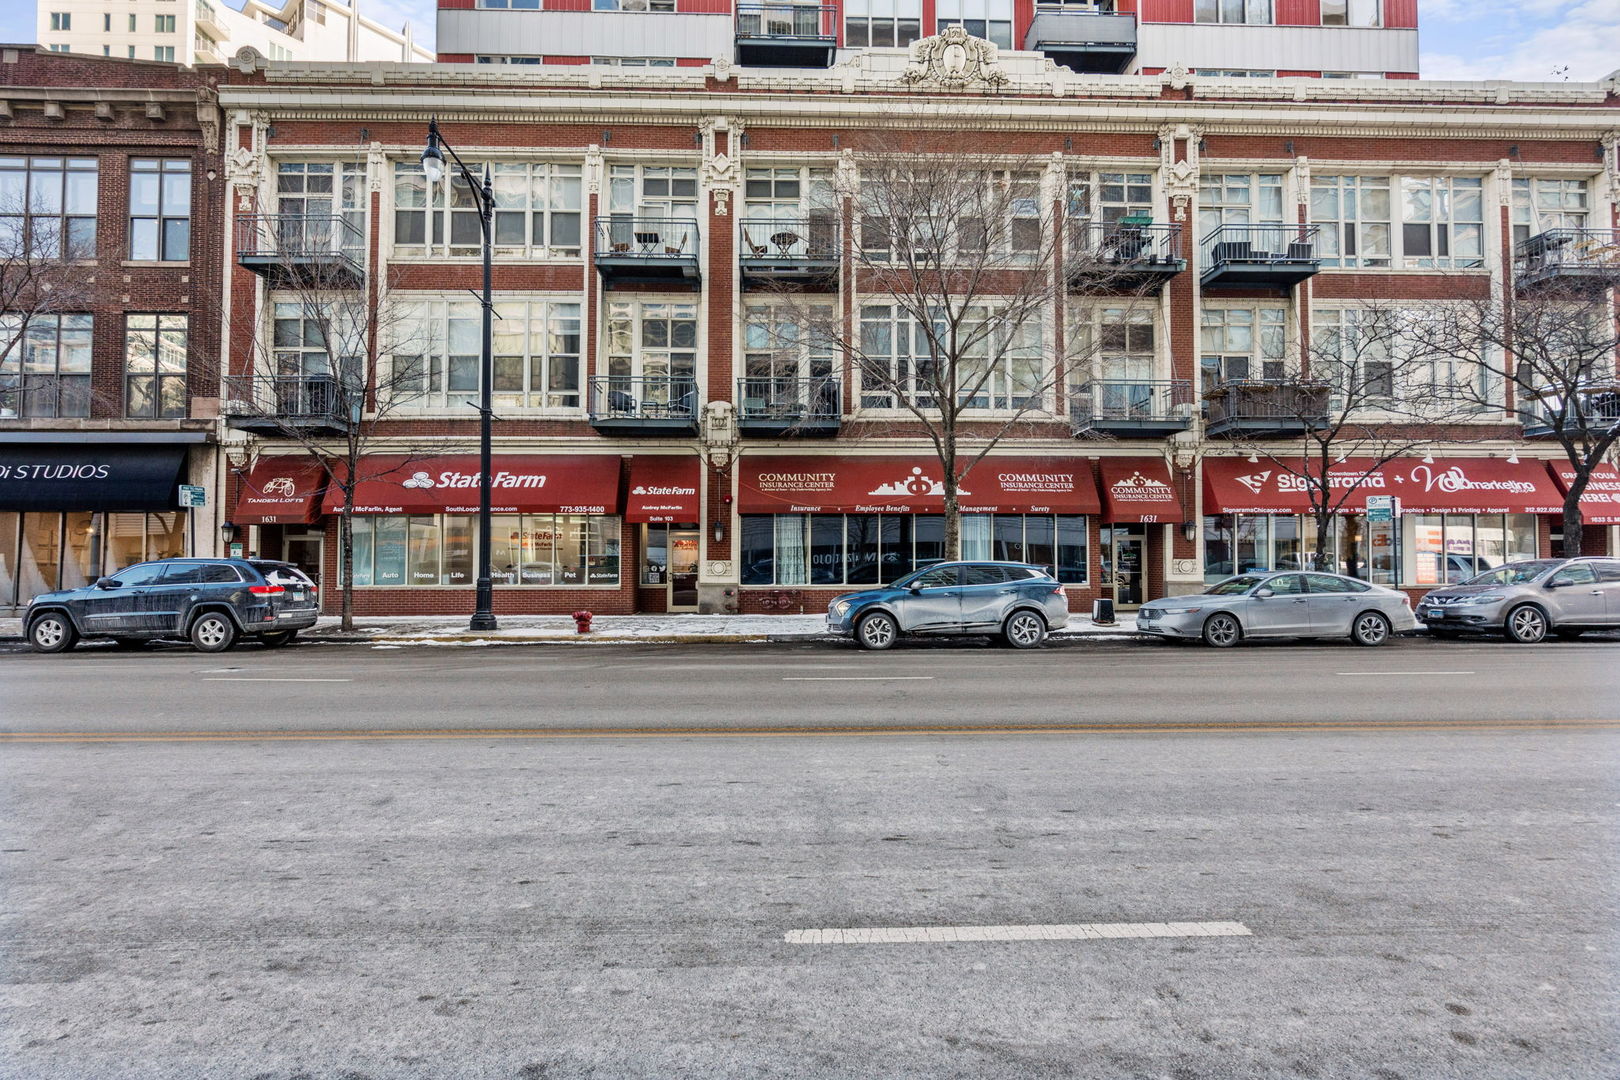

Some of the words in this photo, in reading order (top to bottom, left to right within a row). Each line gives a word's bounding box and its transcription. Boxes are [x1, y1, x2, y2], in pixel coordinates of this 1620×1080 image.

[14, 464, 110, 479] STUDIOS
[436, 472, 546, 488] StatFarm
[998, 474, 1073, 482] COMMUNITY
[1567, 482, 1620, 490] SINESS
